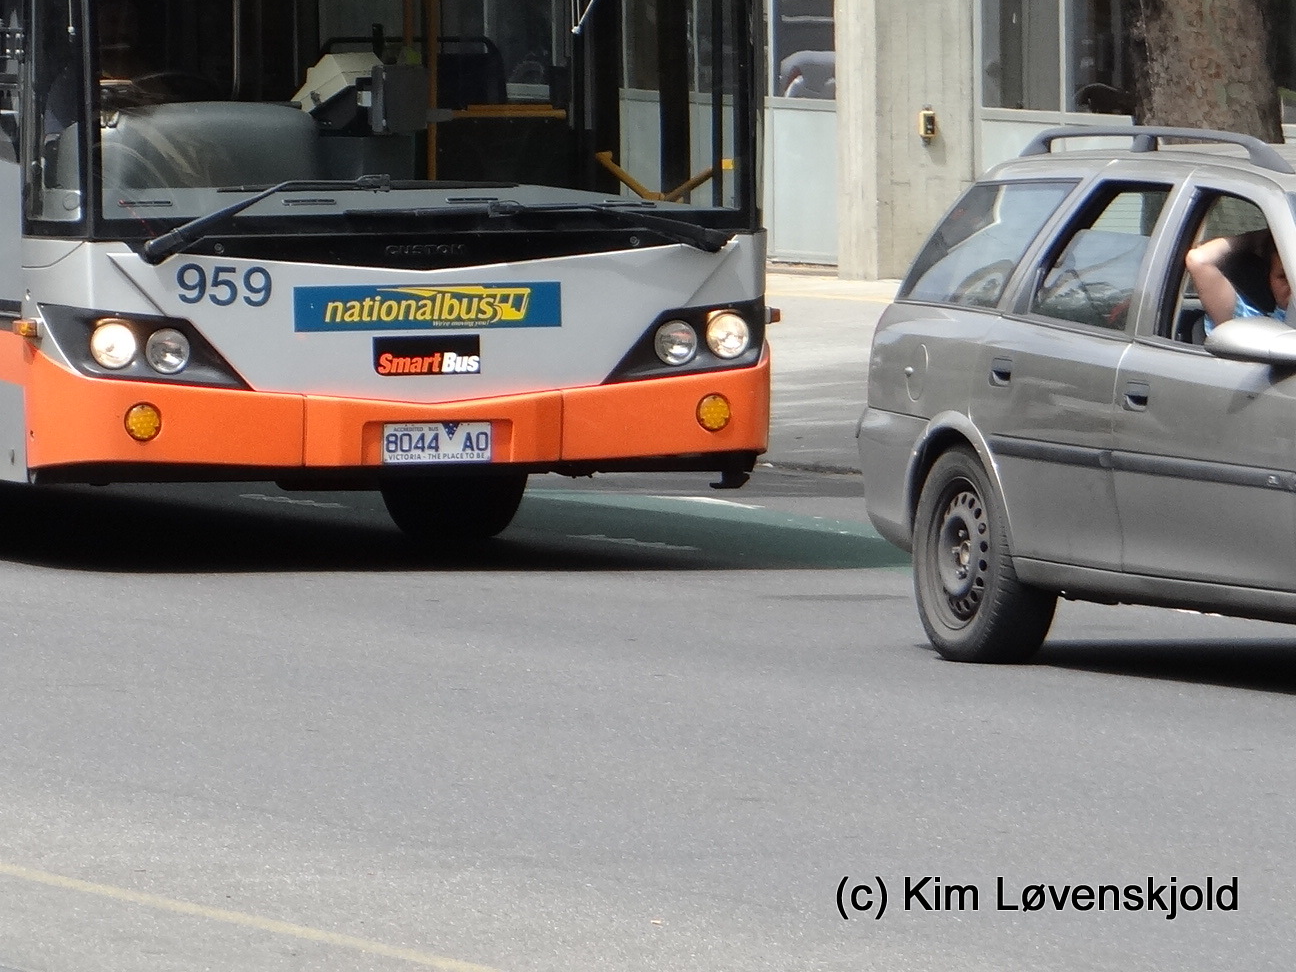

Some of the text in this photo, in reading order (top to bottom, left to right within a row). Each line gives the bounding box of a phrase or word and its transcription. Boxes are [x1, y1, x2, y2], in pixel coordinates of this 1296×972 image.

[177, 263, 271, 307] 959
[325, 292, 497, 323] nationalbus
[378, 352, 479, 374] SmartBus
[385, 432, 440, 454] 8044
[388, 453, 422, 461] VICTORIA
